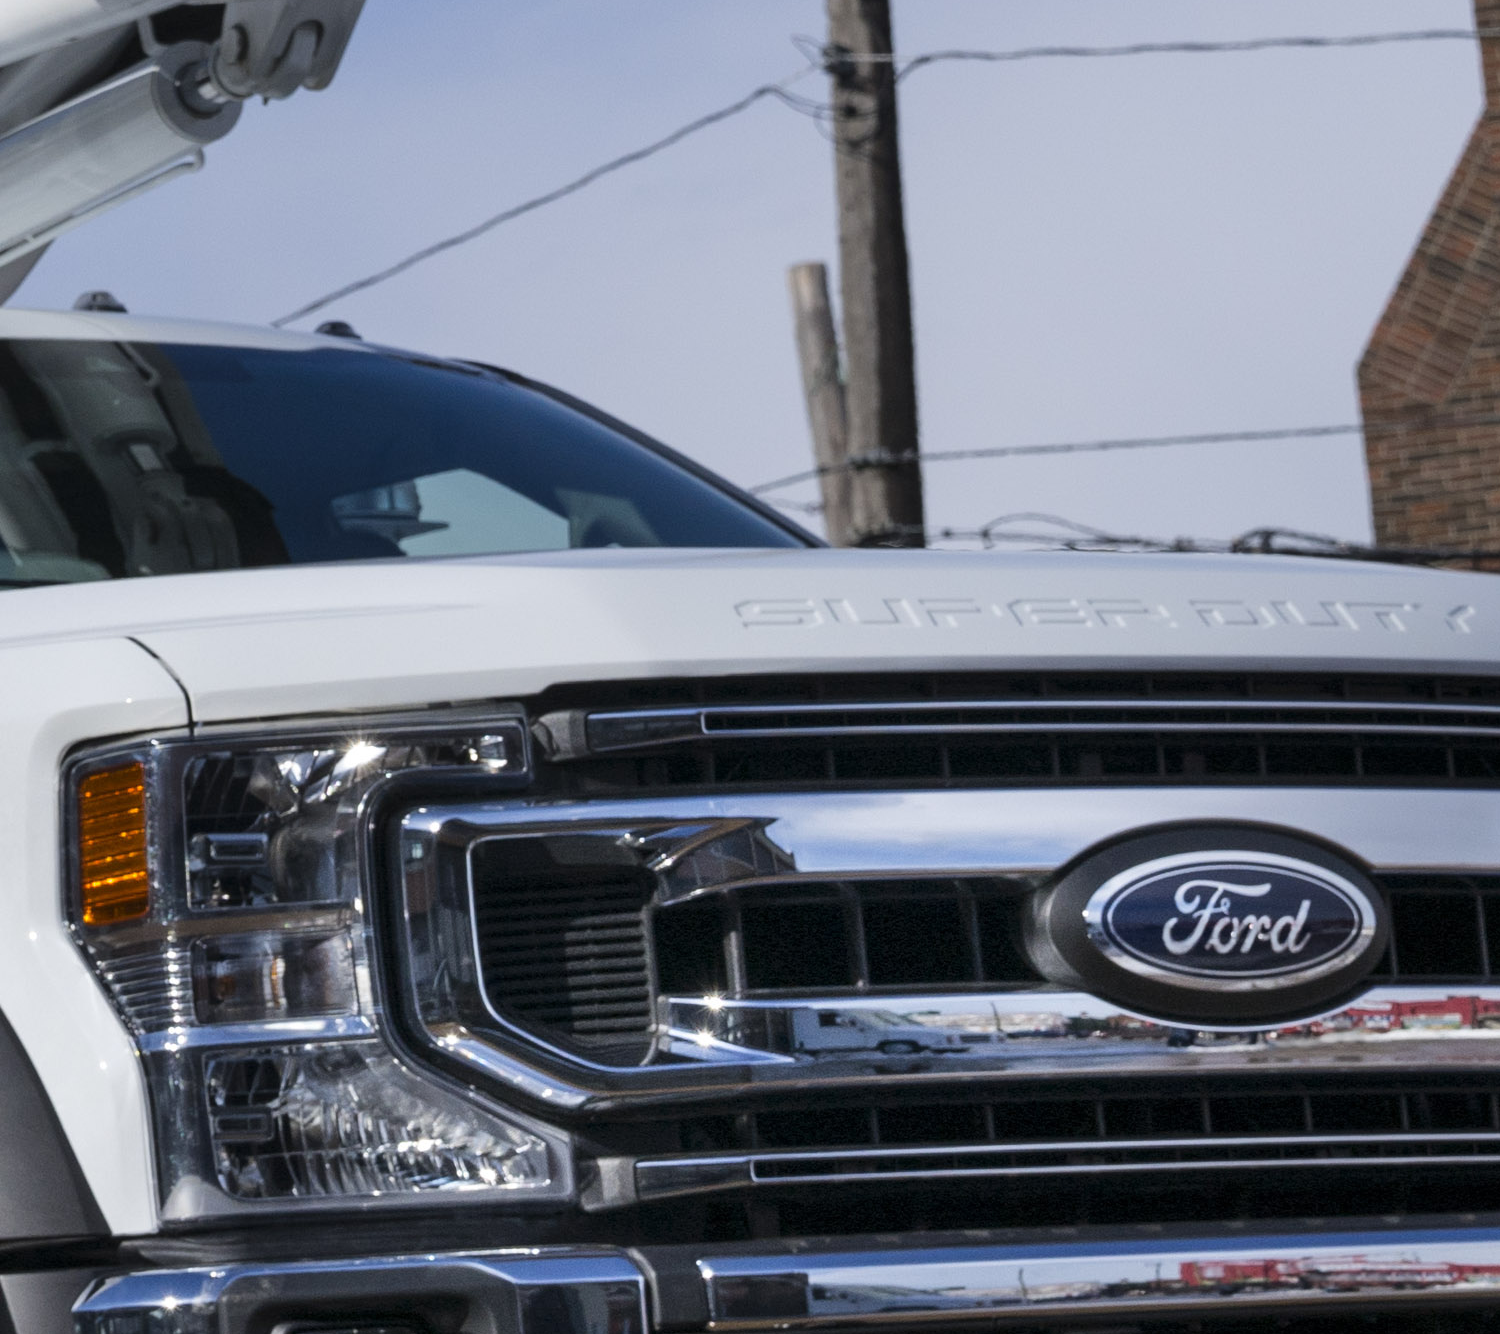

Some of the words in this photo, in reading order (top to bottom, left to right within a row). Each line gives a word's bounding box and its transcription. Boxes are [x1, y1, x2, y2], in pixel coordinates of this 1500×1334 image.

[733, 597, 1179, 629] SUPER
[1187, 598, 1476, 634] DUTY
[1162, 879, 1312, 955] Ford
